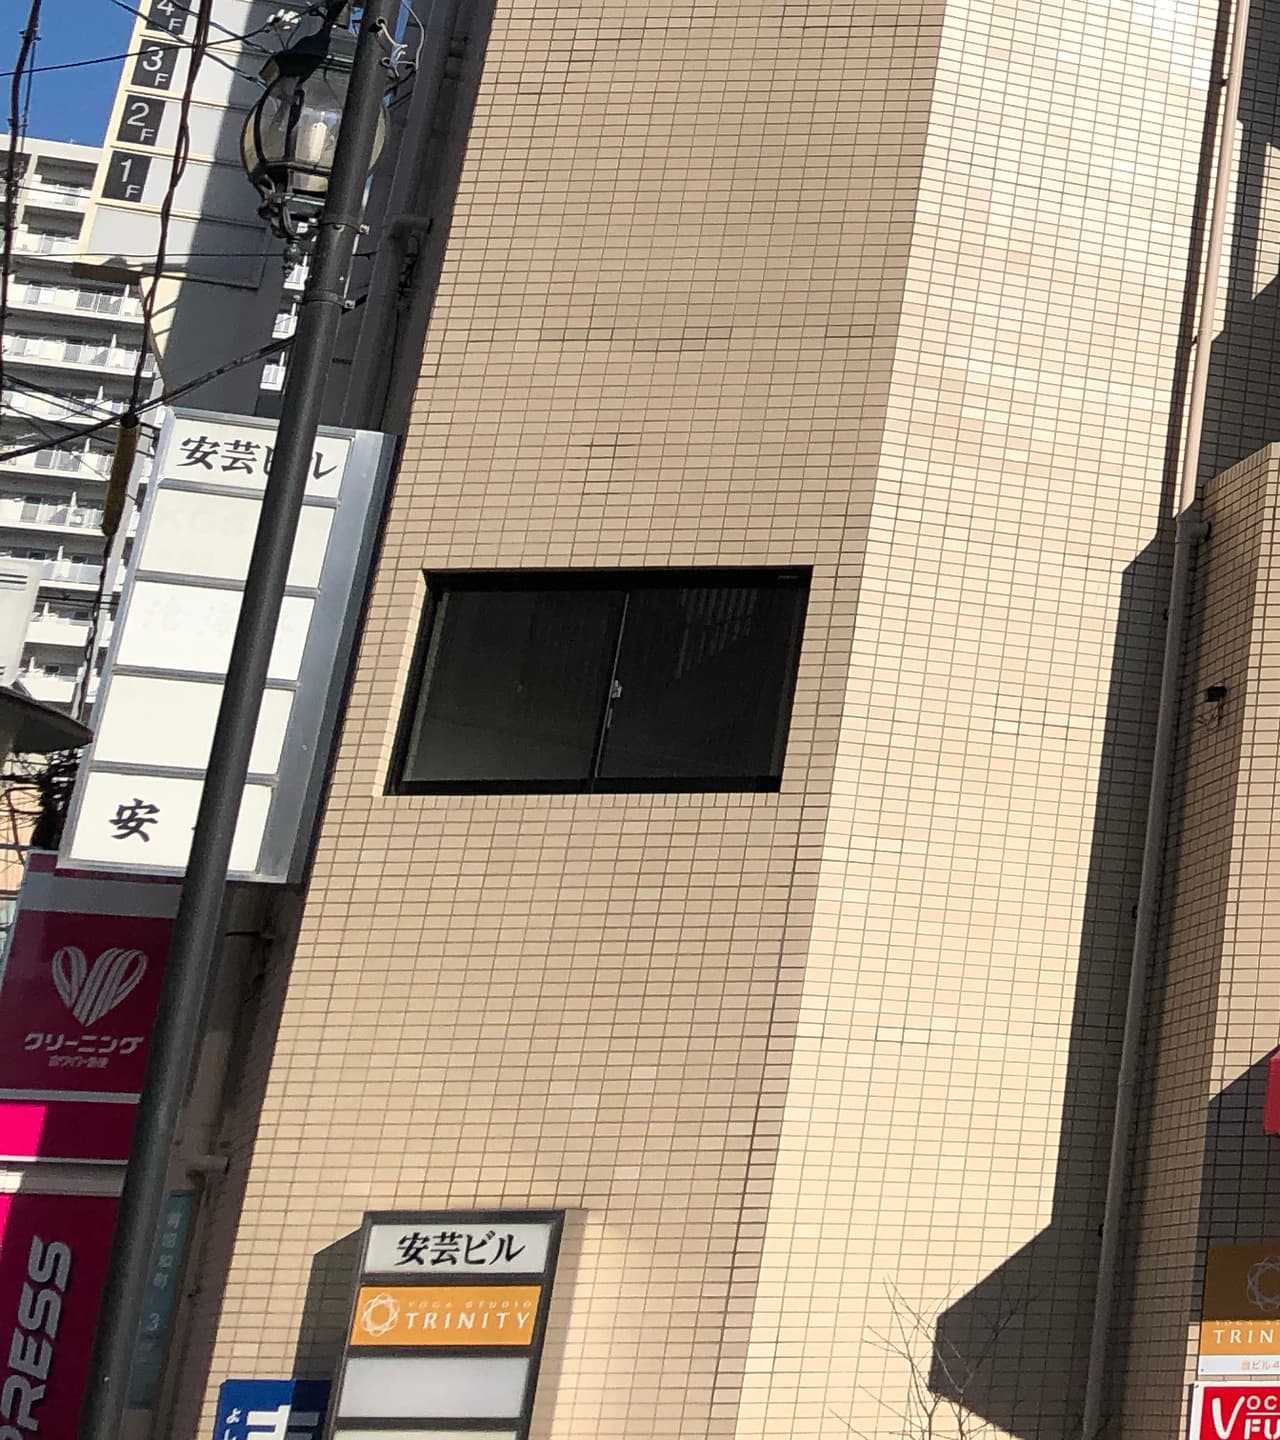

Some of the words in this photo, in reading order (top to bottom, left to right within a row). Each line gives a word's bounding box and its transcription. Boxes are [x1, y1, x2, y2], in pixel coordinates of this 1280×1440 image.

[142, 47, 169, 87] 3F
[127, 102, 154, 142] 2F
[120, 159, 141, 197] 1F
[24, 1032, 145, 1054] クリーニング
[394, 1230, 527, 1267] 安芸ビル
[405, 1310, 531, 1330] TRINITY
